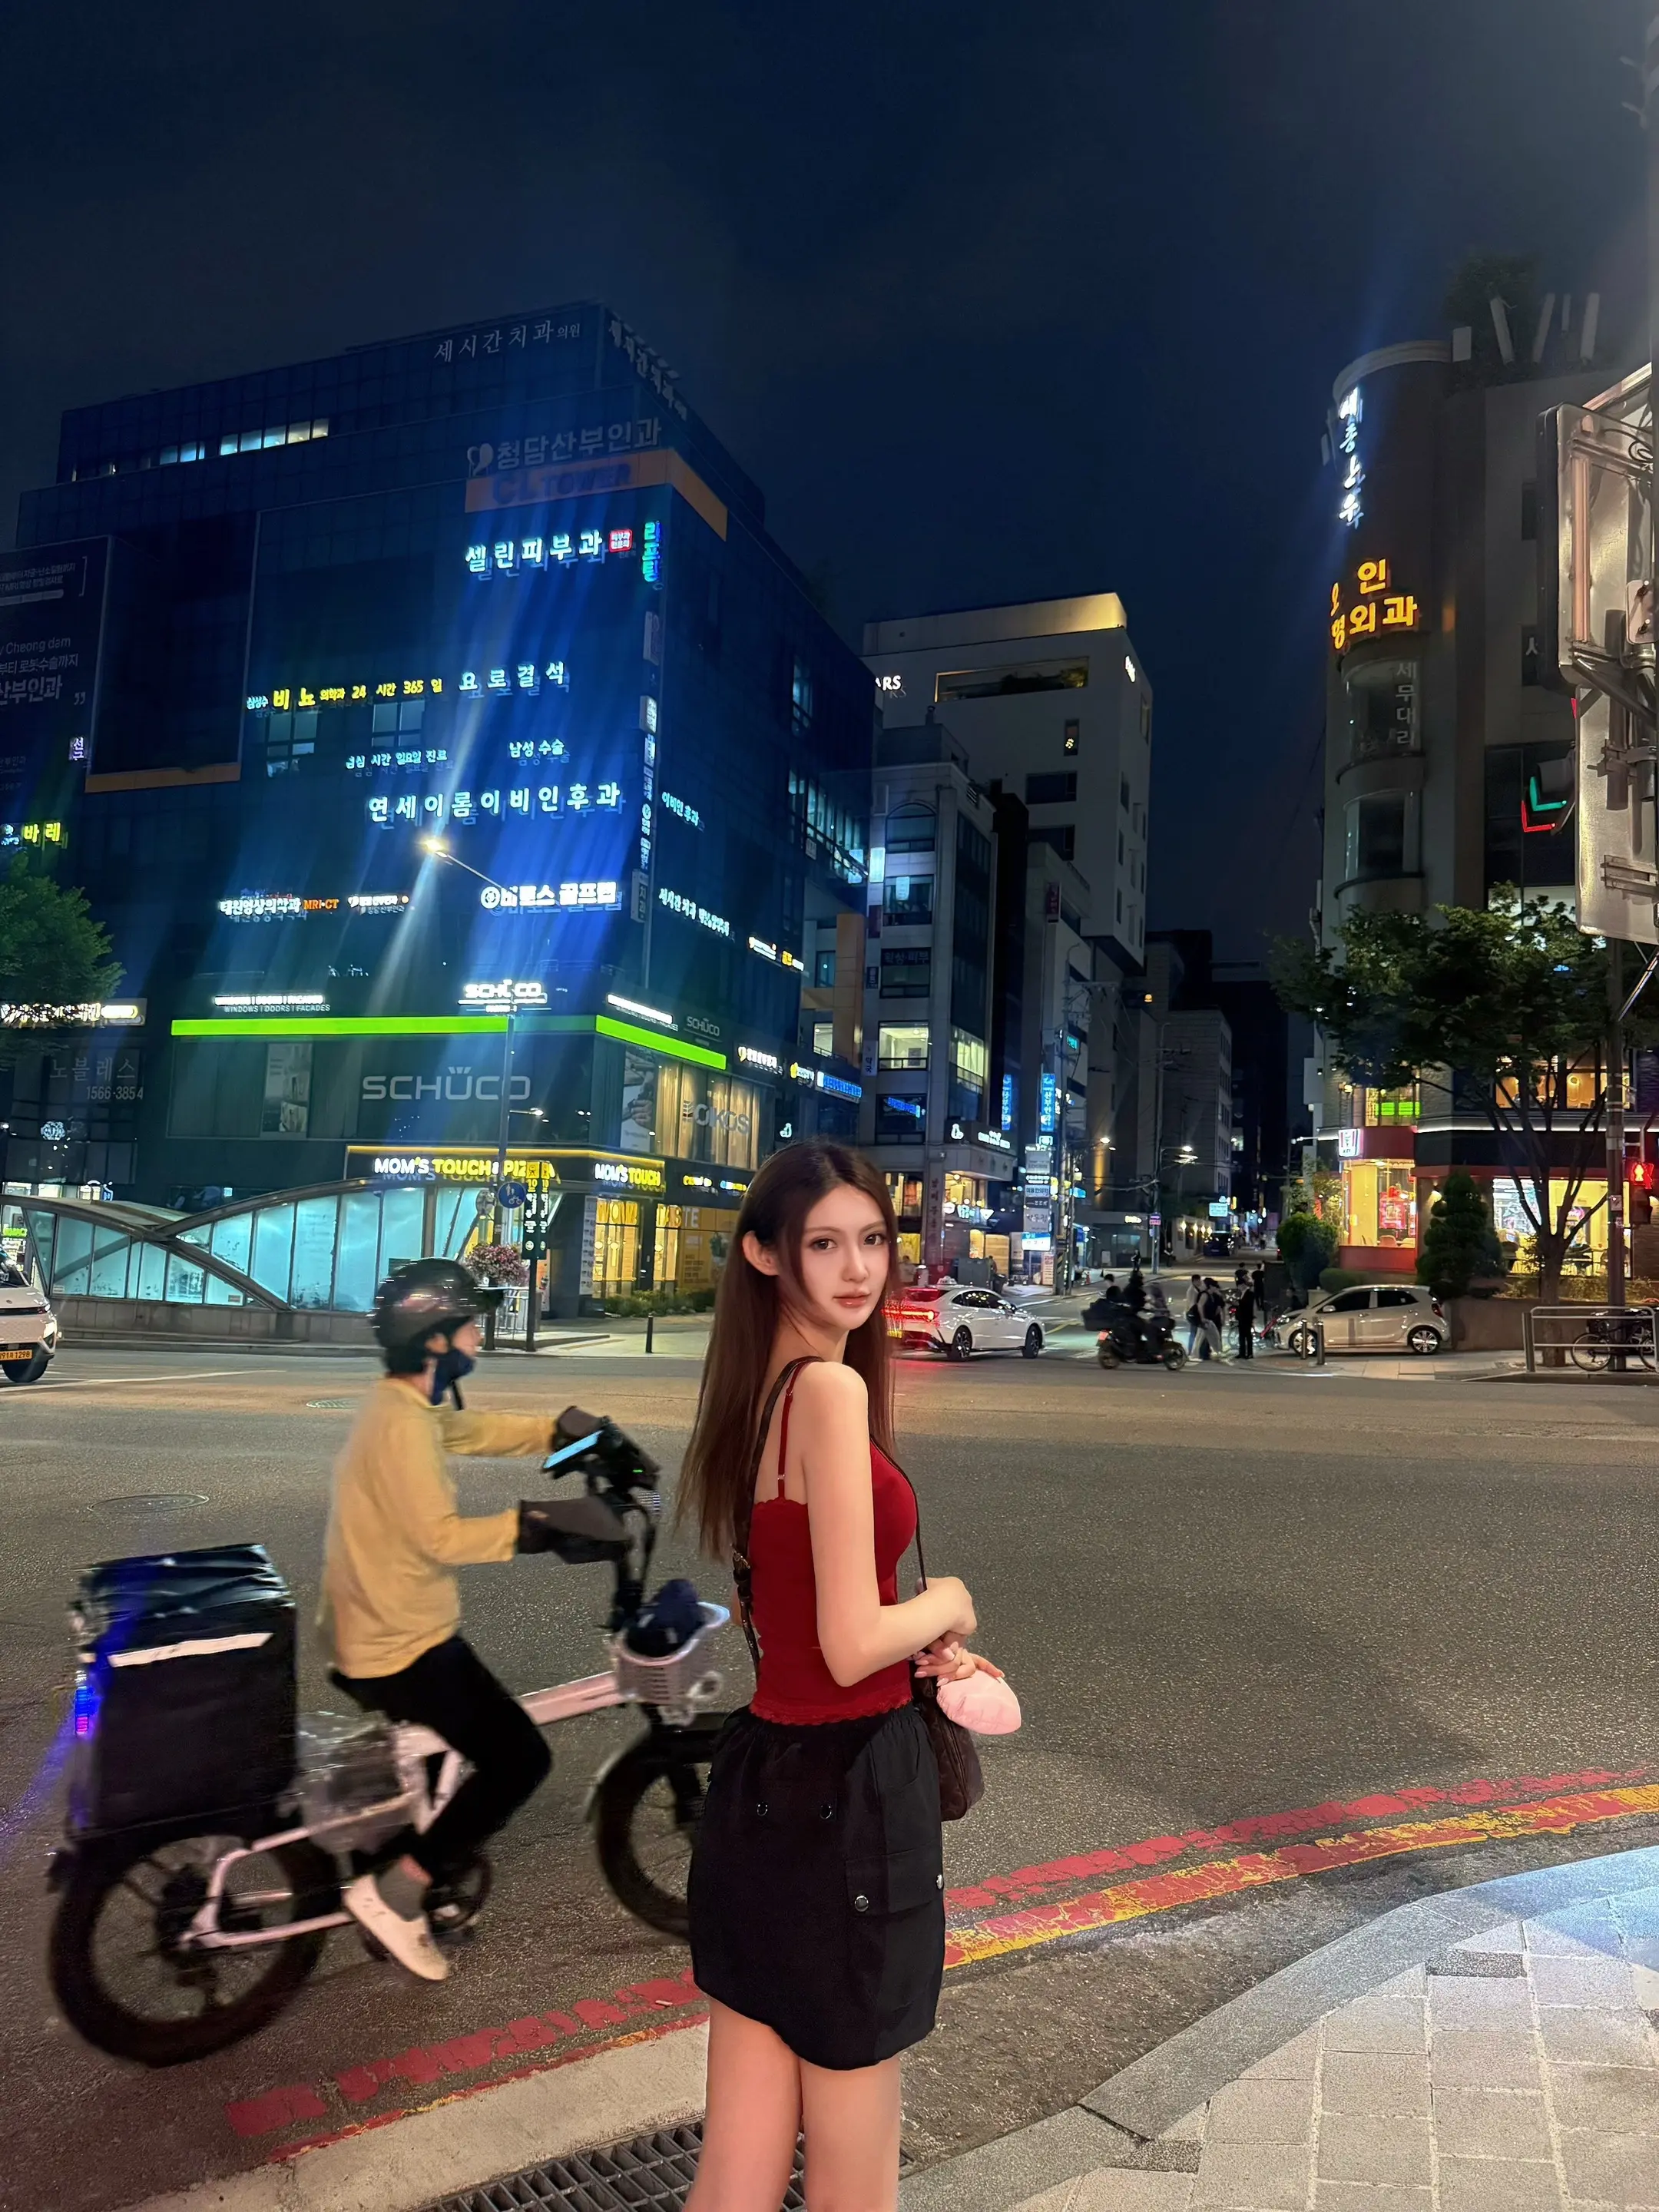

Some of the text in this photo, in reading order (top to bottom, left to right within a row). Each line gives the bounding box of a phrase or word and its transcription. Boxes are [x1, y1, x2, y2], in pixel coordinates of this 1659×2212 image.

[434, 320, 555, 363] 세시간치과
[496, 417, 662, 470] 청담산부인과
[465, 529, 602, 573] 셀린피부과
[5, 637, 71, 654] Cheong dam
[459, 661, 565, 690] 요로결석
[352, 684, 366, 700] 24
[375, 682, 396, 697] 시간
[402, 679, 424, 695] 365
[430, 677, 443, 694] 일
[1396, 662, 1416, 747] 세무대리
[371, 753, 392, 767] 시간
[426, 749, 448, 763] 진료
[508, 738, 565, 759] 남성 수술
[50, 1056, 136, 1081] 노블레스
[362, 1066, 531, 1100] SCHÜCO
[374, 1157, 429, 1174] MOM'S
[432, 1158, 492, 1176] TOUCH
[594, 1163, 629, 1184] MOM'S
[628, 1167, 661, 1187] TOUCH
